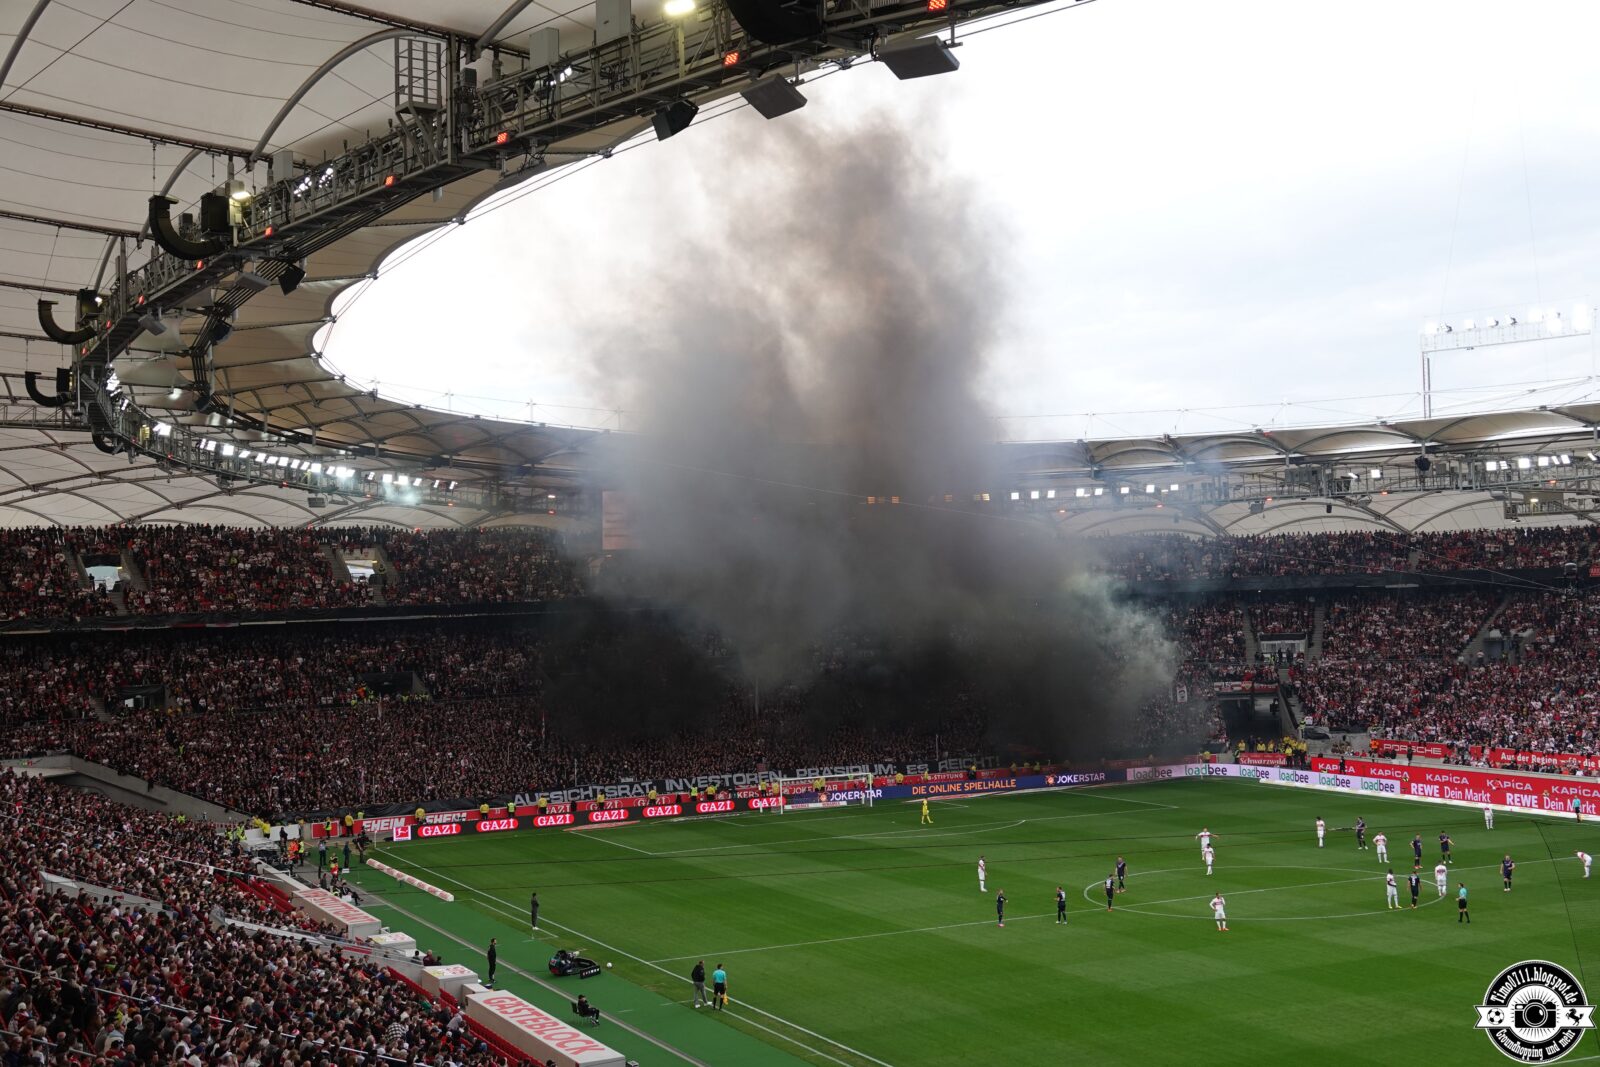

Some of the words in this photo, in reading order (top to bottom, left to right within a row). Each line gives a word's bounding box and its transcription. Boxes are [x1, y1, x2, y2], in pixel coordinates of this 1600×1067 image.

[1383, 743, 1442, 755] PORSCHE
[1517, 753, 1529, 761] der
[1531, 754, 1558, 765] Region
[1583, 758, 1595, 767] die
[1133, 767, 1172, 779] loadbee
[1184, 764, 1228, 776] loadbee
[1239, 766, 1270, 779] loadbee
[1279, 770, 1309, 783] loadbee
[1057, 772, 1105, 784] JOKERSTAR
[1318, 773, 1351, 788] loadbee
[912, 786, 927, 795] DIE
[928, 783, 962, 794] ONLINE
[964, 779, 1017, 791] SPIELHALLE
[1360, 778, 1395, 793] loadbee
[830, 789, 882, 801] JOKERSTAR
[1411, 783, 1440, 797] REWE
[1444, 786, 1462, 799] Dein
[1465, 788, 1491, 803] Markt
[1506, 793, 1538, 808] REWE
[1543, 796, 1564, 810] Dein
[362, 818, 406, 832] EHEIM
